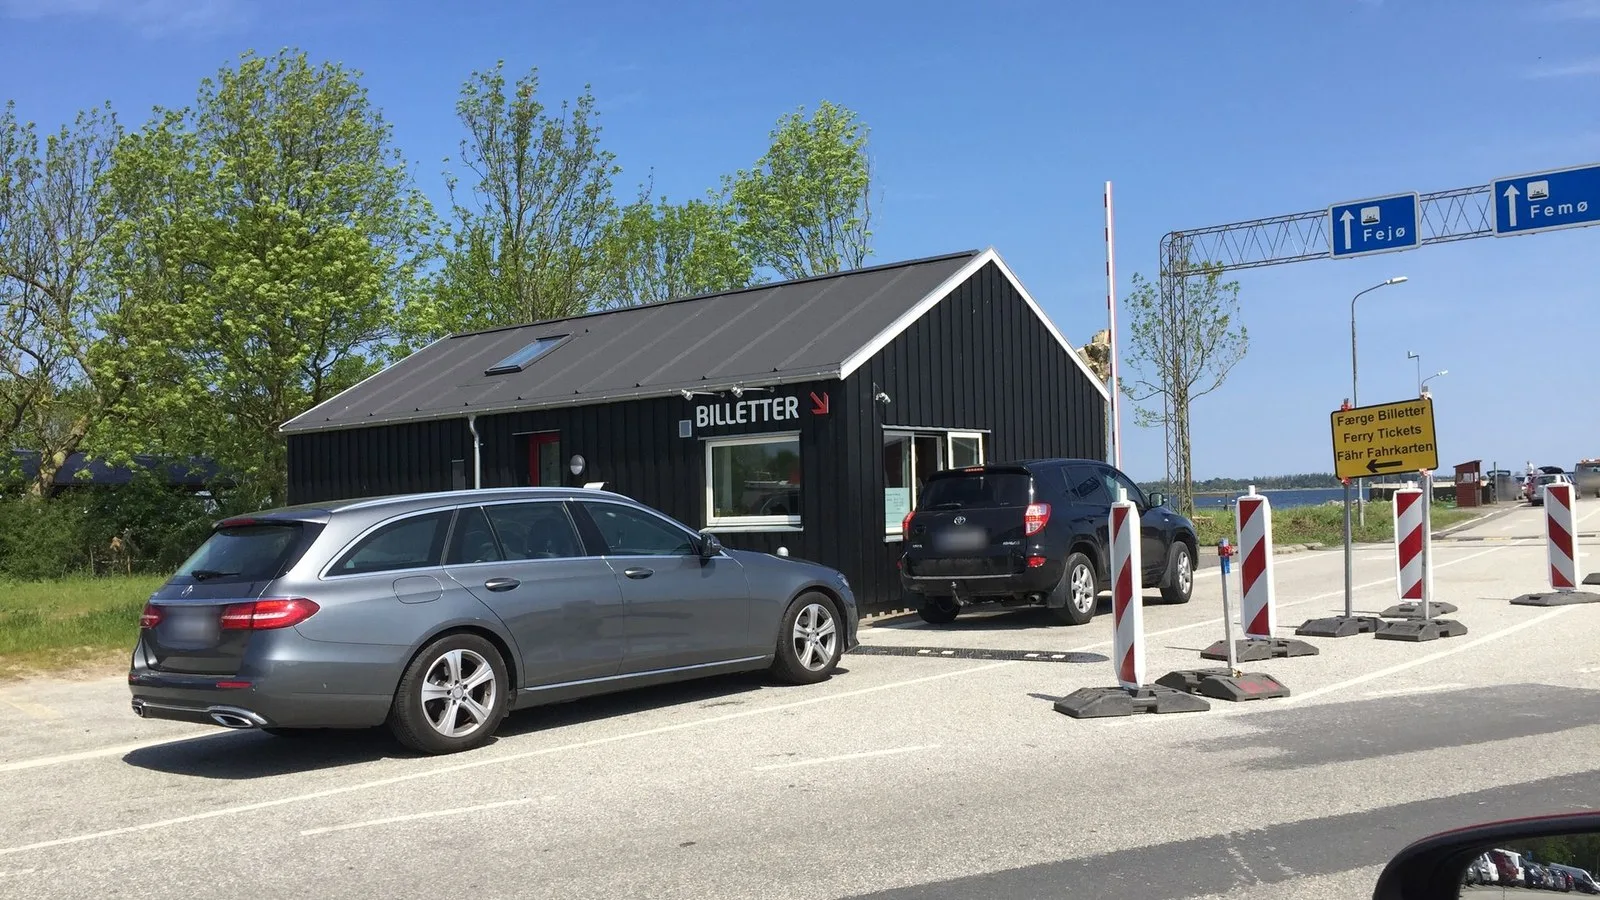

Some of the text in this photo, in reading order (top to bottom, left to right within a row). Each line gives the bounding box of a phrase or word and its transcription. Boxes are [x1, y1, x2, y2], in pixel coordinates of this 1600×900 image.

[1530, 201, 1588, 219] Femø
[1363, 226, 1406, 242] Fejø
[696, 396, 799, 427] BILLETTER
[1337, 406, 1426, 426] Færge Billetter
[1343, 425, 1422, 443] Ferry Tickets
[1337, 443, 1433, 461] Fähr Fahrkarten
